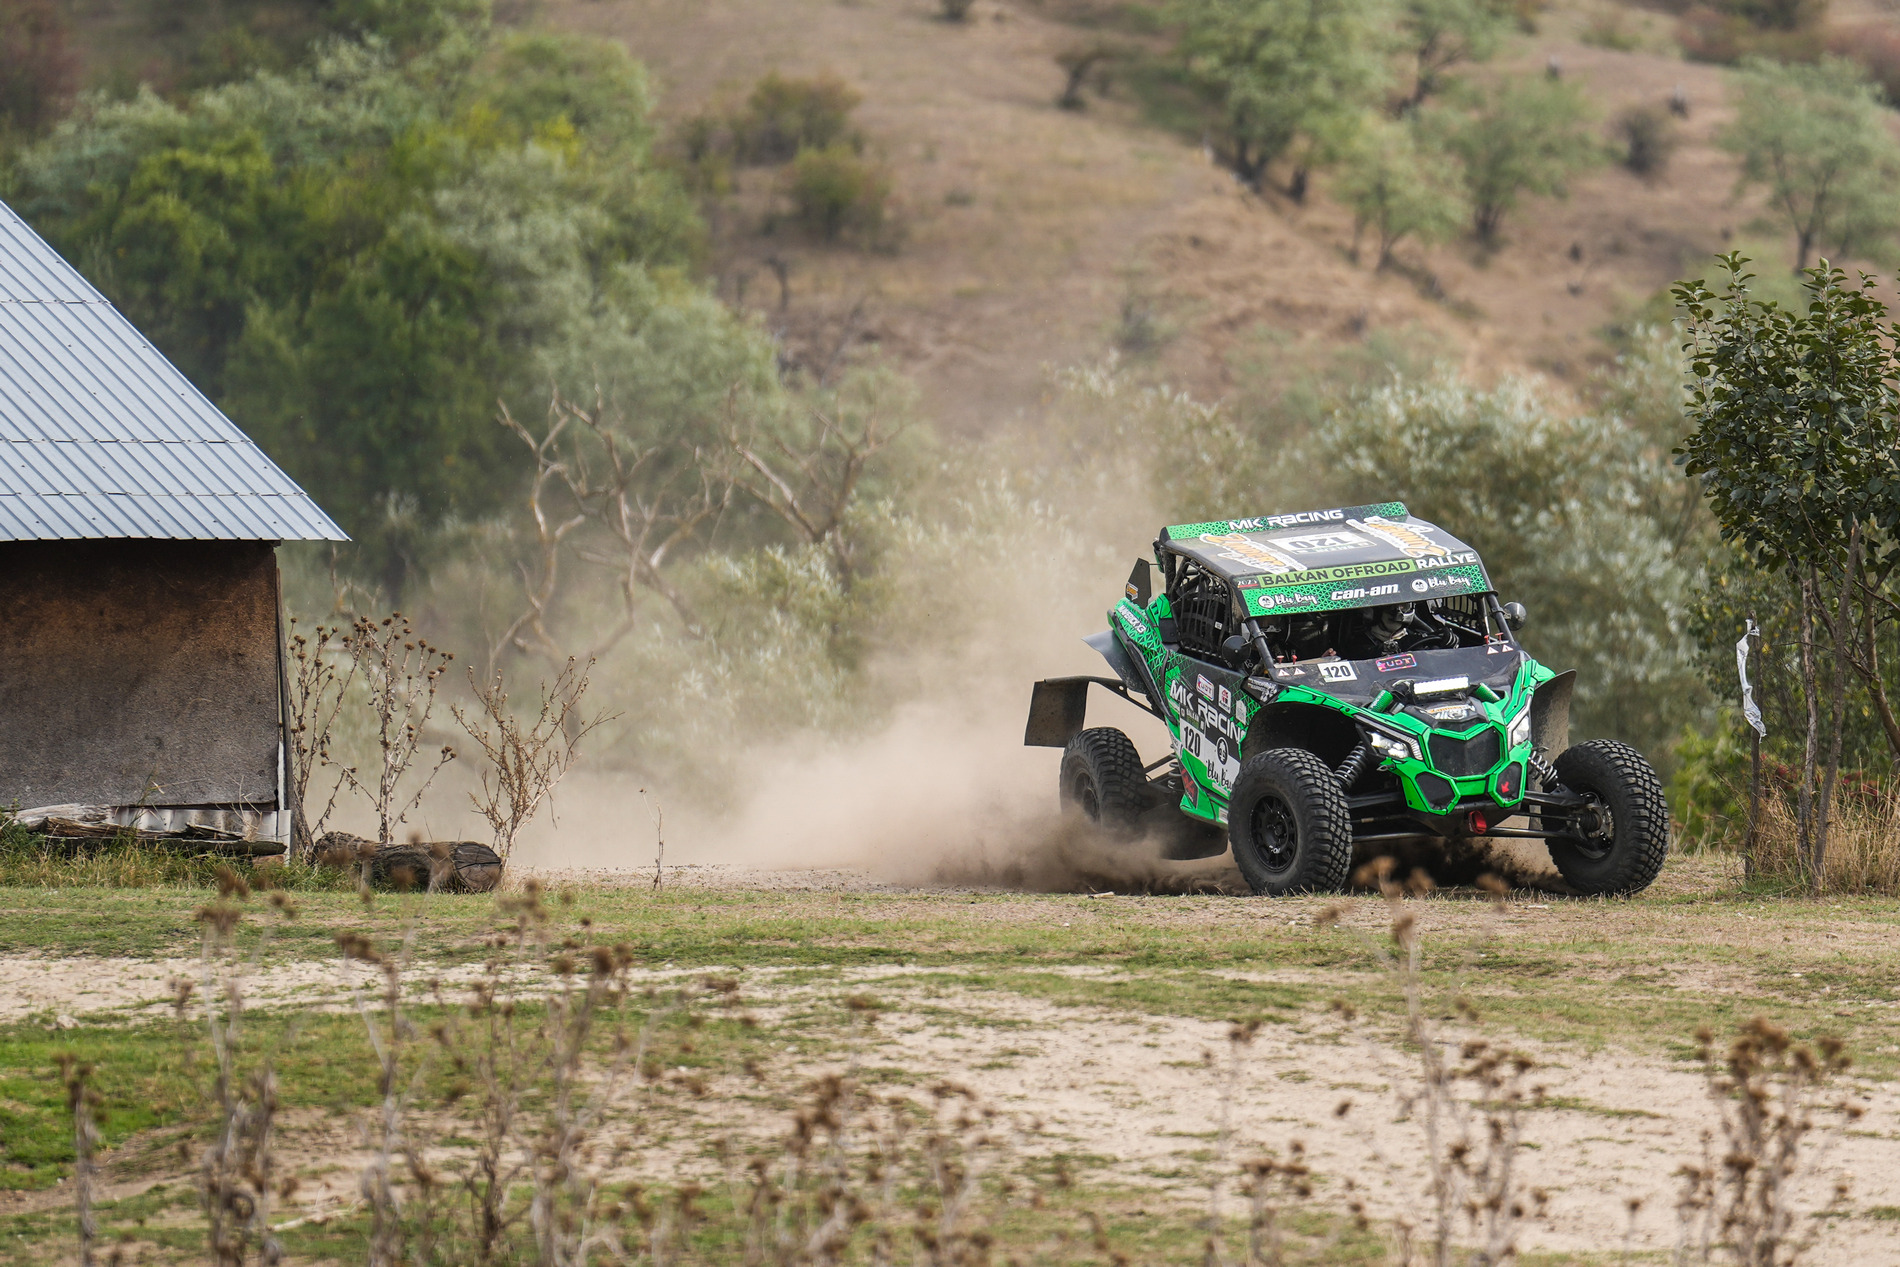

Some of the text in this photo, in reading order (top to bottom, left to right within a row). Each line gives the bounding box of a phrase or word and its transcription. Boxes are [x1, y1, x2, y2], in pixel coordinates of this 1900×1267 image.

[1228, 509, 1344, 531] MK RACING
[1261, 553, 1477, 587] BALKAN OFFROAD RALLYE
[1331, 583, 1399, 601] can-am
[1323, 665, 1351, 678] 120
[1169, 679, 1194, 710] MK
[1184, 726, 1201, 758] 120
